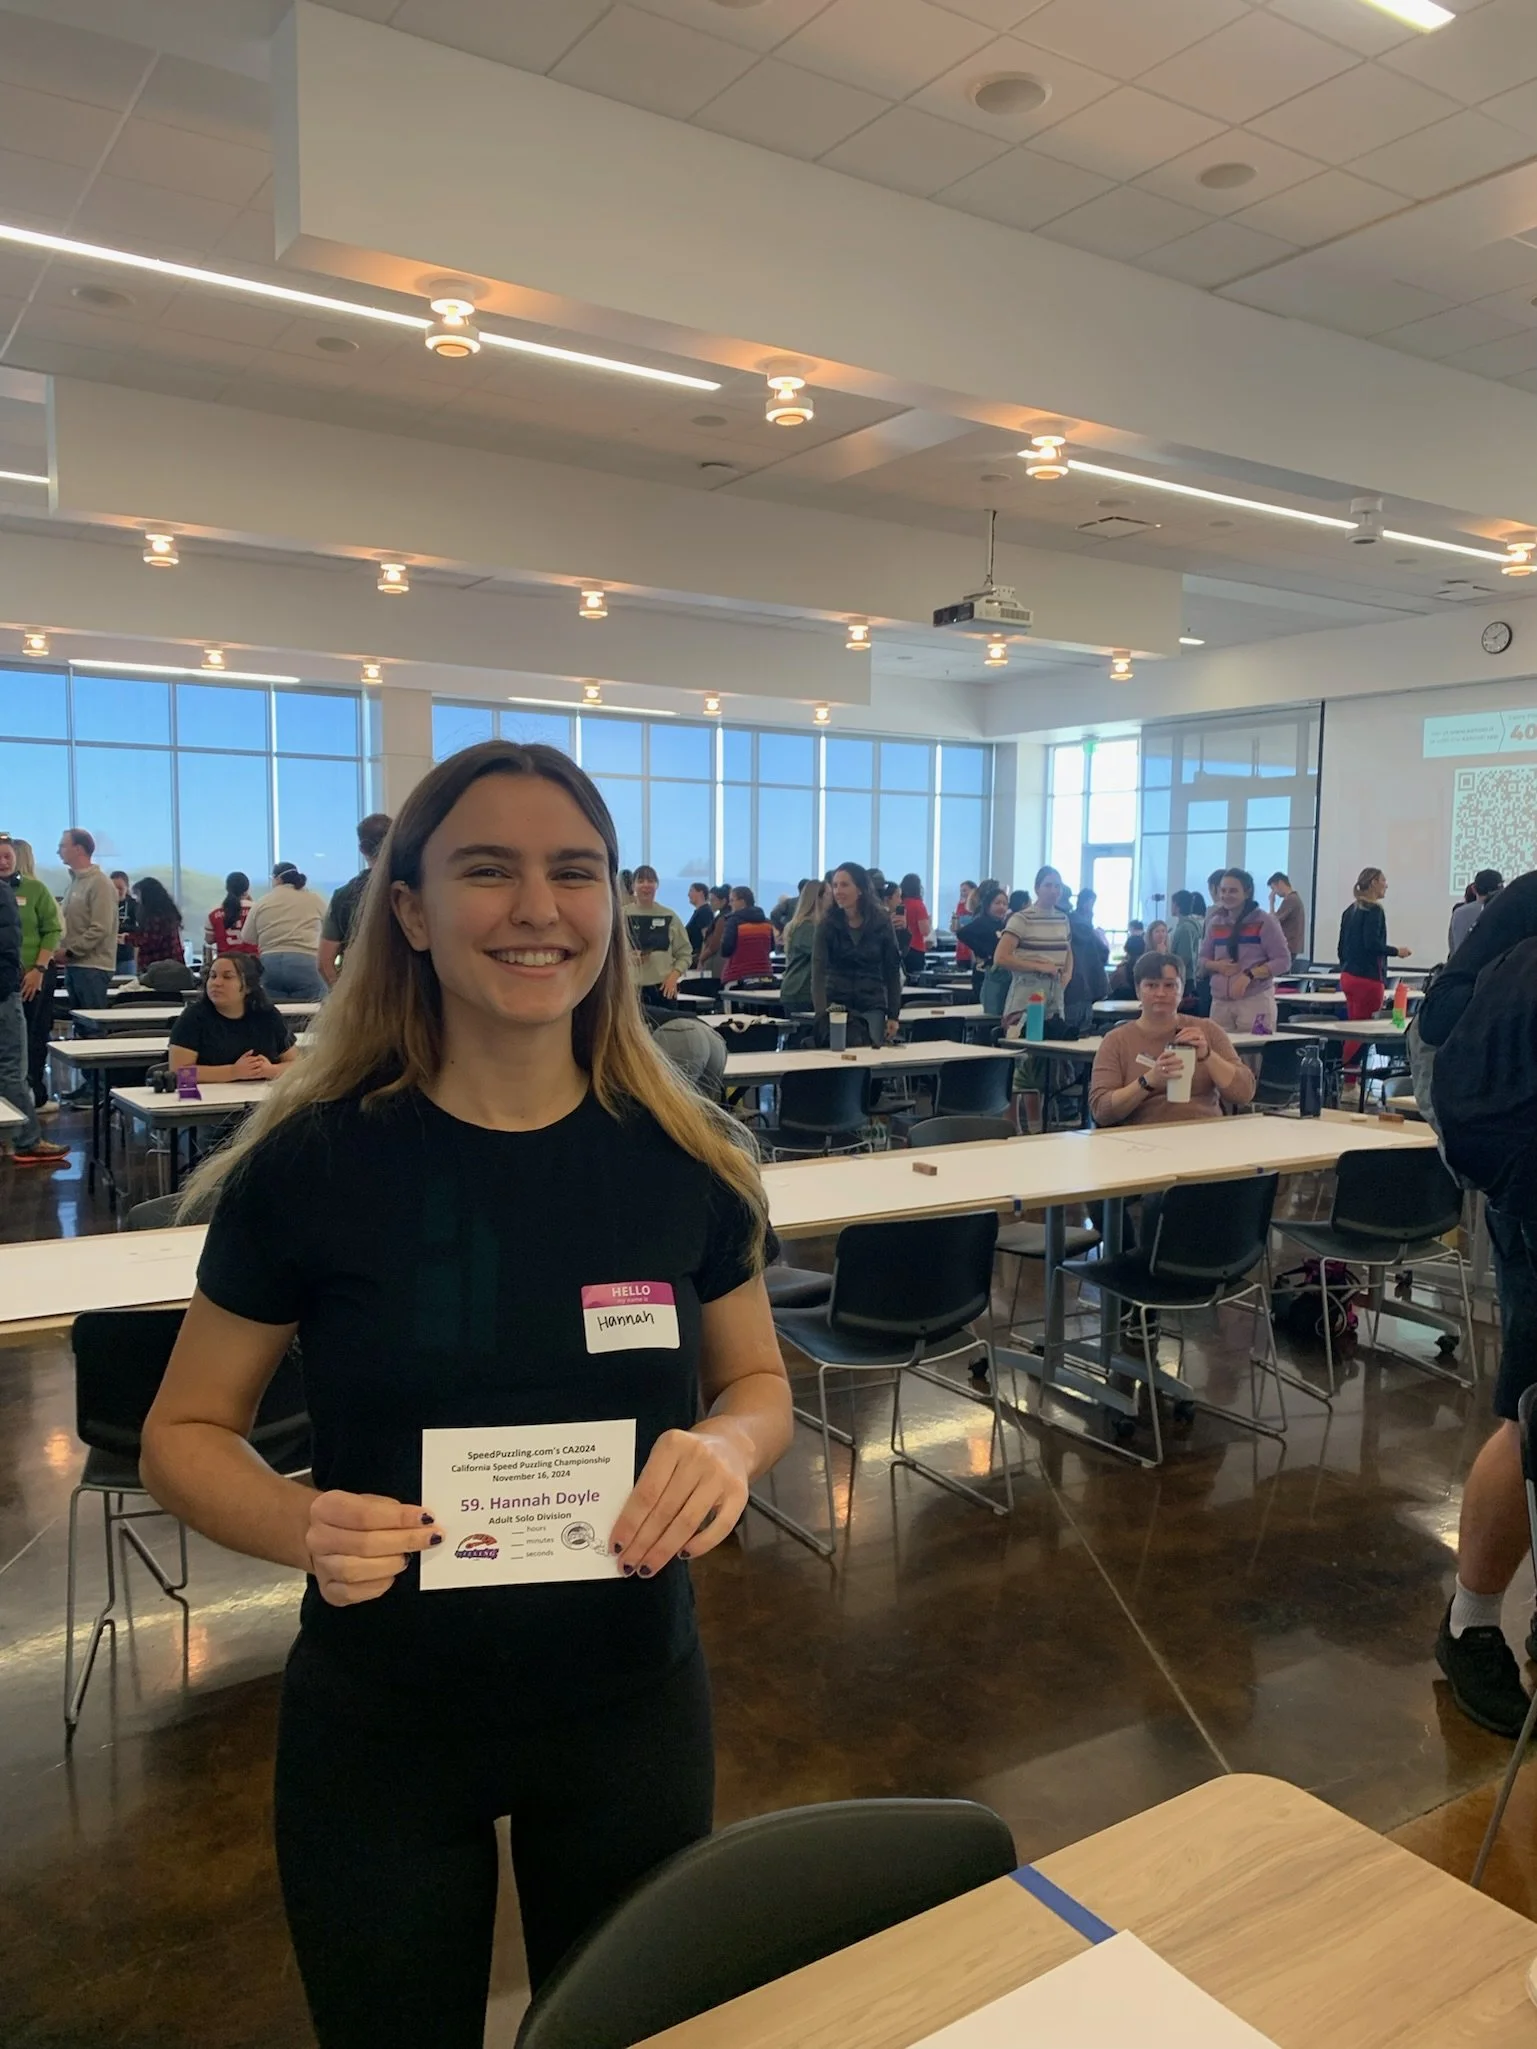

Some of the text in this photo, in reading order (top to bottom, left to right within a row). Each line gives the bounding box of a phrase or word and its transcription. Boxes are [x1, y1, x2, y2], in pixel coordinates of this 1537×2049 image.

[612, 1285, 651, 1297] HELLO
[597, 1310, 655, 1331] Hannah
[467, 1444, 596, 1461] SpeedPuzzling.com's CA2024
[451, 1456, 611, 1473] California Speed Puzzling Championship
[492, 1470, 571, 1482] November 16, 2024
[460, 1488, 601, 1512] 59. Hannah Doyle
[488, 1510, 572, 1525] Adult Solo Division
